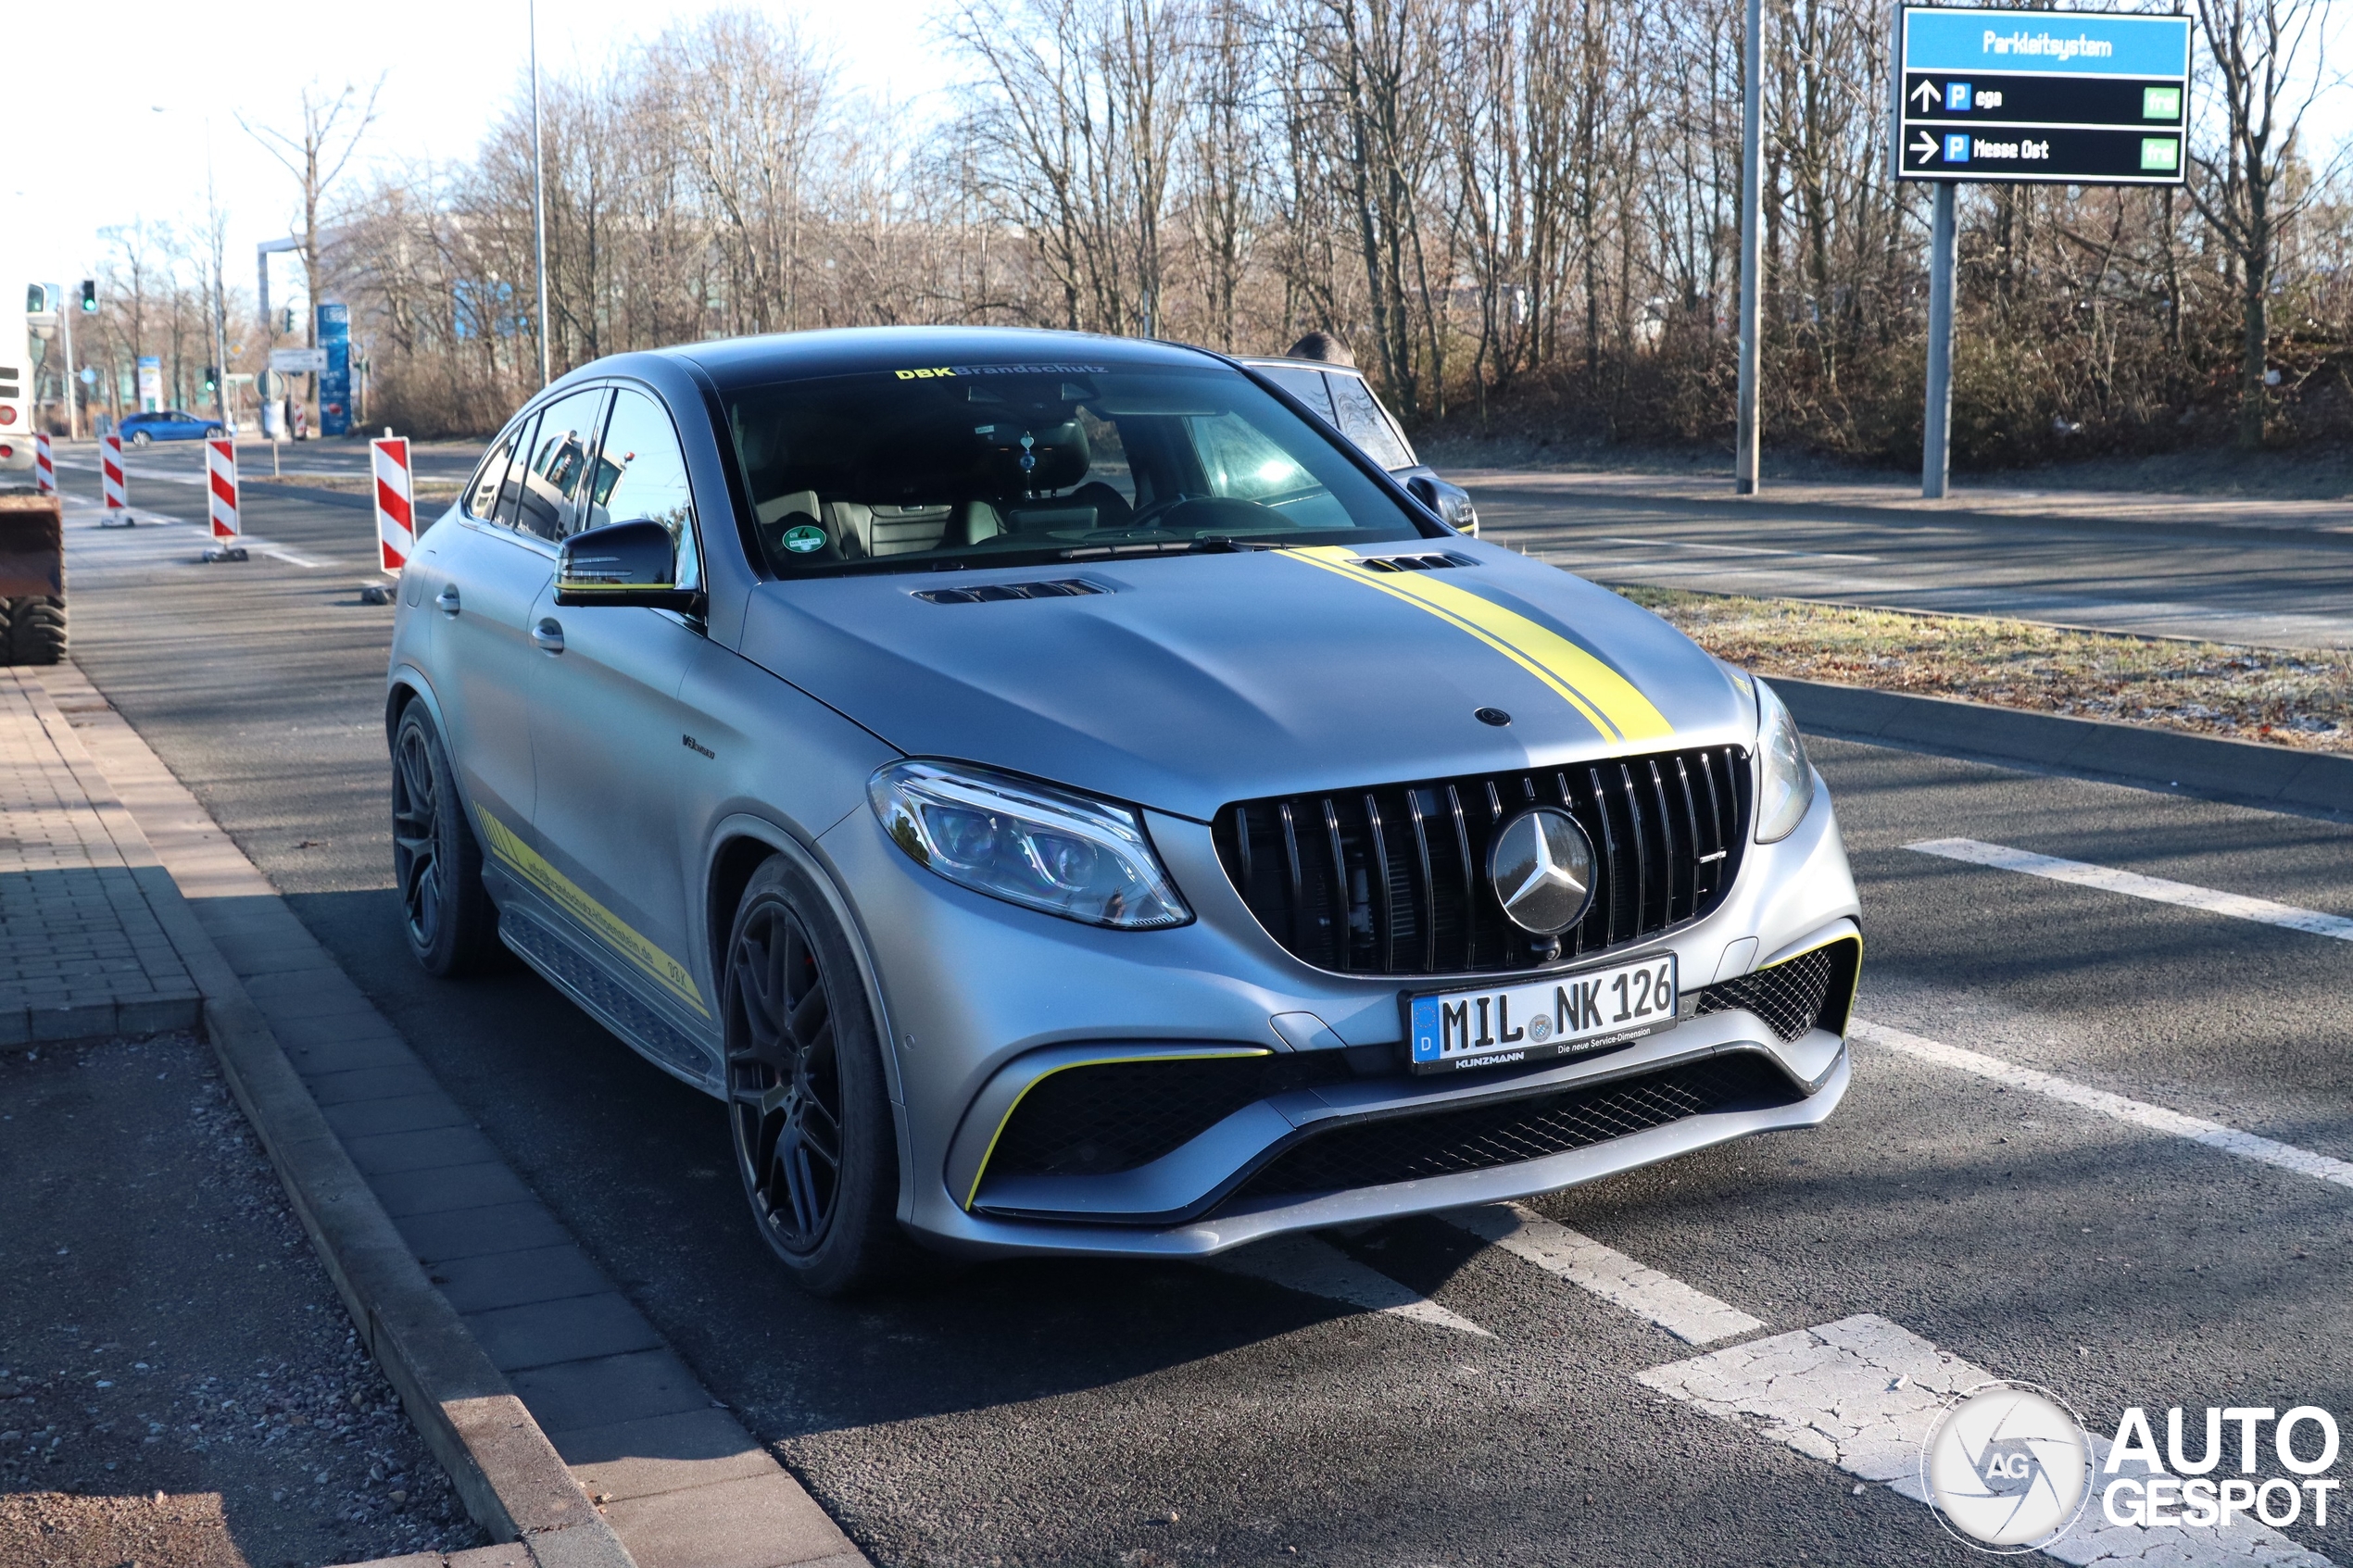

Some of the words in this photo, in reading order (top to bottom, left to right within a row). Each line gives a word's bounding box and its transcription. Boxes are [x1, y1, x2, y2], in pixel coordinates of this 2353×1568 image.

[1983, 30, 2112, 61] Parkleitsystem
[1951, 84, 1966, 108] P
[1975, 91, 2003, 109] ega
[1949, 136, 1964, 159] P
[1973, 138, 2019, 158] Messe
[2021, 139, 2049, 159] Ost
[799, 527, 810, 539] 4
[1442, 994, 1524, 1052] MIL
[1556, 978, 1603, 1035] NK
[1612, 963, 1671, 1022] 126
[1421, 1036, 1431, 1052] D
[1557, 1045, 1570, 1054] Die
[1571, 1042, 1590, 1052] neue
[1591, 1028, 1651, 1047] Service-Dimension
[1455, 1051, 1525, 1069] KUNZMANN
